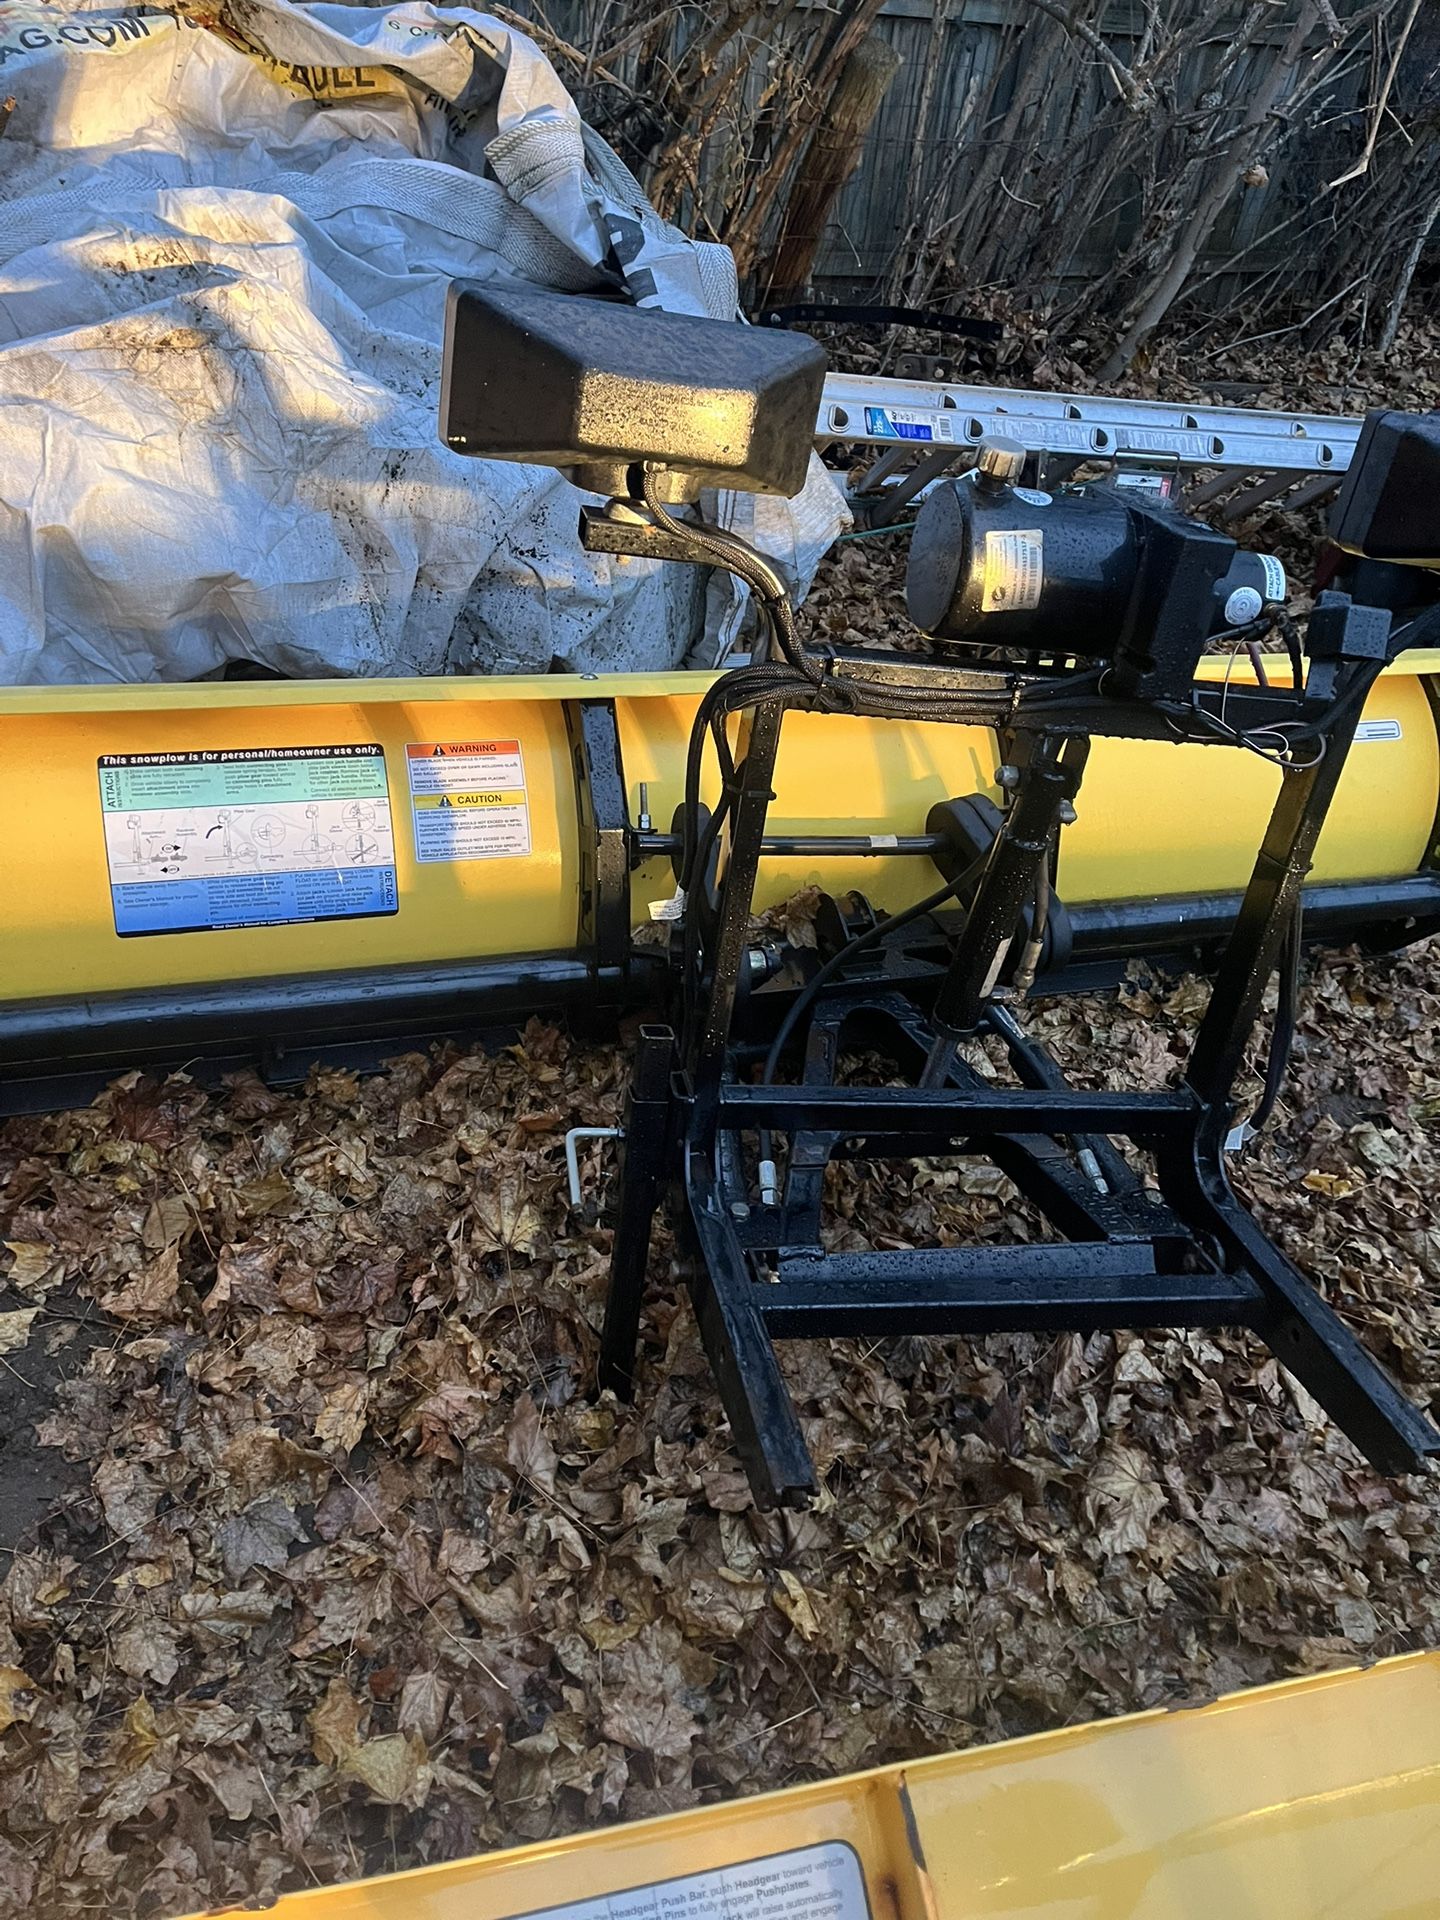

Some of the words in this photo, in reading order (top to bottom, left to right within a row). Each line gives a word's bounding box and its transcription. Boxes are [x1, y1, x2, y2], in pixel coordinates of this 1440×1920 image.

[102, 756, 126, 764] This
[130, 753, 185, 764] snowplow
[188, 752, 198, 760] is
[202, 751, 217, 760] for
[220, 748, 331, 761] personal/homeowner
[355, 745, 380, 756] only.
[449, 744, 497, 753] WARNING
[105, 771, 115, 808] ATTACH
[457, 794, 502, 805] CAUTION
[384, 871, 395, 906] DETACH
[610, 1901, 658, 1920] Headgear
[661, 1894, 686, 1911] Push
[710, 1883, 733, 1899] push
[734, 1872, 780, 1892] Headgear
[782, 1864, 812, 1879] toward
[814, 1856, 845, 1872] vehicle
[664, 1908, 686, 1920] Pins
[688, 1905, 698, 1917] to
[699, 1900, 718, 1916] fully
[721, 1893, 754, 1911] engage
[746, 1908, 761, 1920] will
[762, 1903, 784, 1917] raise
[785, 1888, 843, 1912] automatically
[810, 1902, 843, 1920] engage
